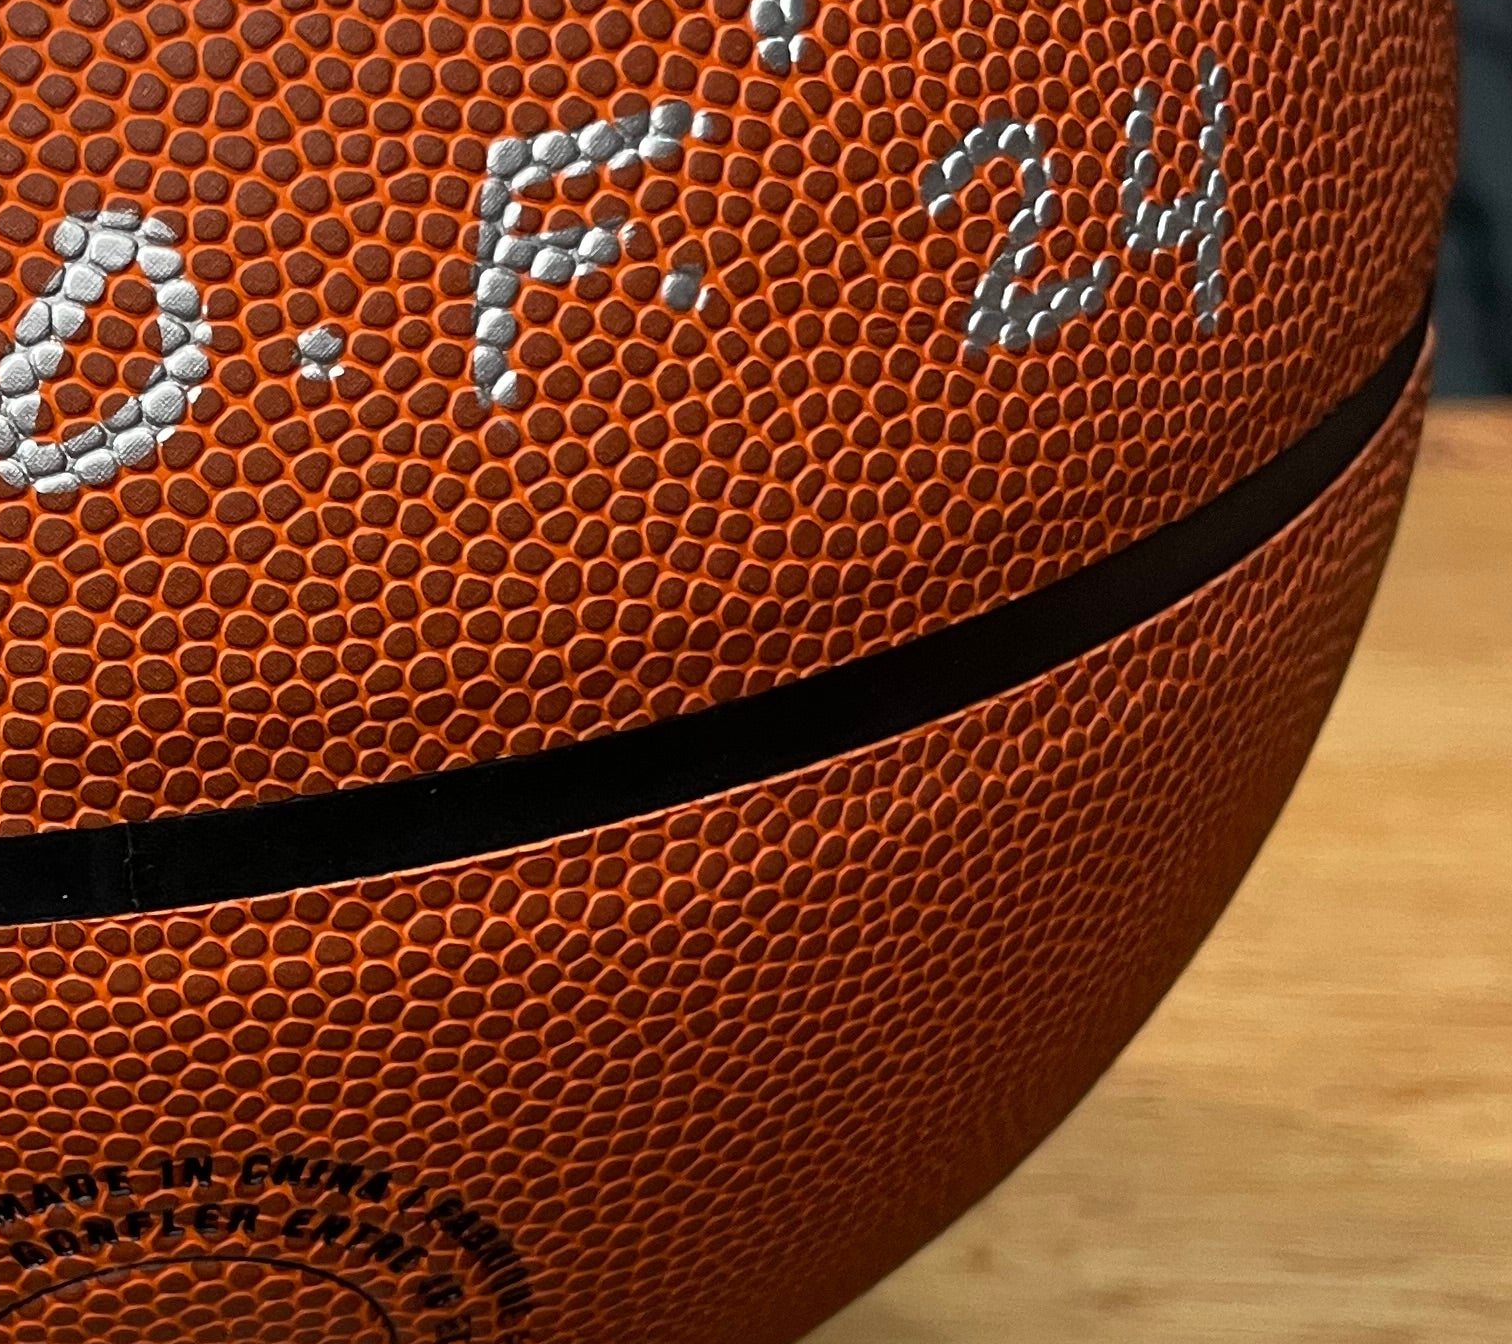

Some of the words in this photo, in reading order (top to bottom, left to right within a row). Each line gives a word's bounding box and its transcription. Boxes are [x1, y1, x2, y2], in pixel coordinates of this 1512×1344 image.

[924, 56, 1229, 353] 24
[161, 1156, 214, 1188] IN
[240, 1156, 393, 1203] CHINA
